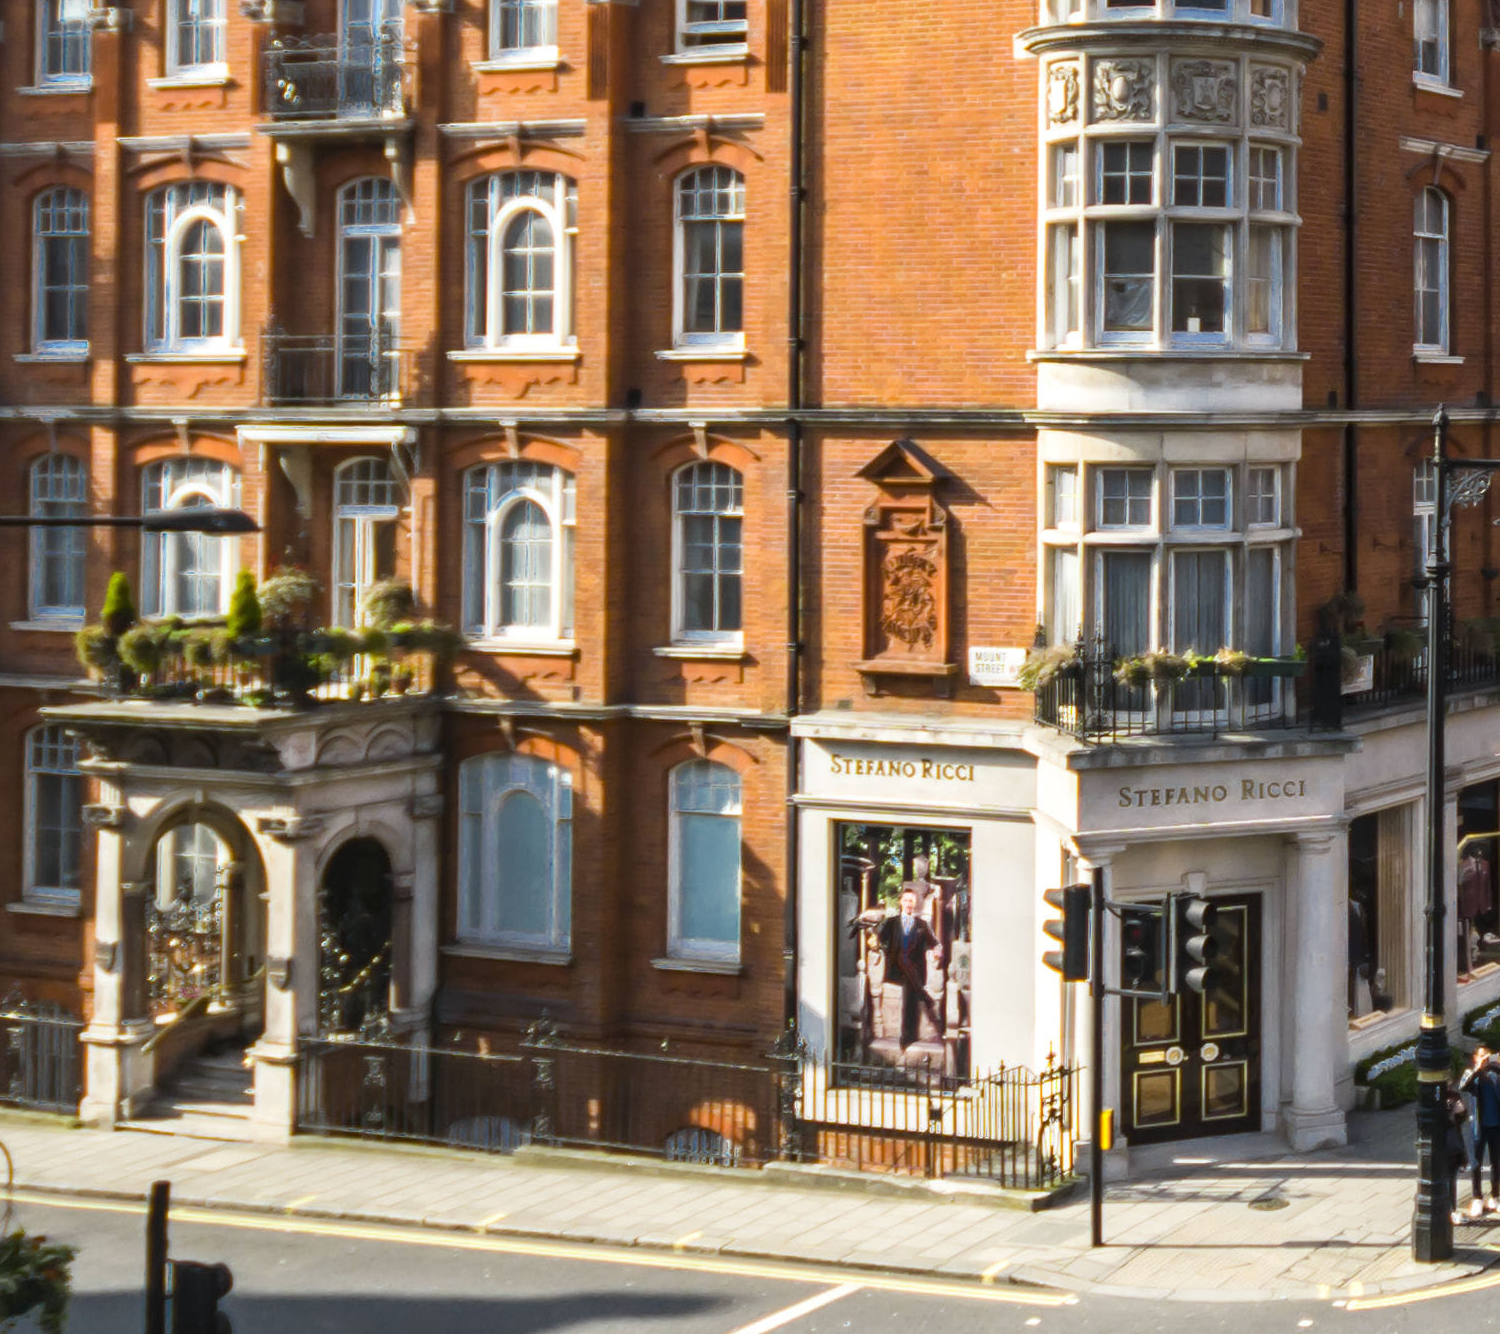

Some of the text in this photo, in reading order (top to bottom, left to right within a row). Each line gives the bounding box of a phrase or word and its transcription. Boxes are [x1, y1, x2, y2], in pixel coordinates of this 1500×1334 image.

[975, 652, 1007, 662] MOUNT
[975, 663, 1005, 674] STREET
[830, 753, 975, 781] STEFANO RICCI
[1118, 779, 1306, 808] STEFANO RICCI
